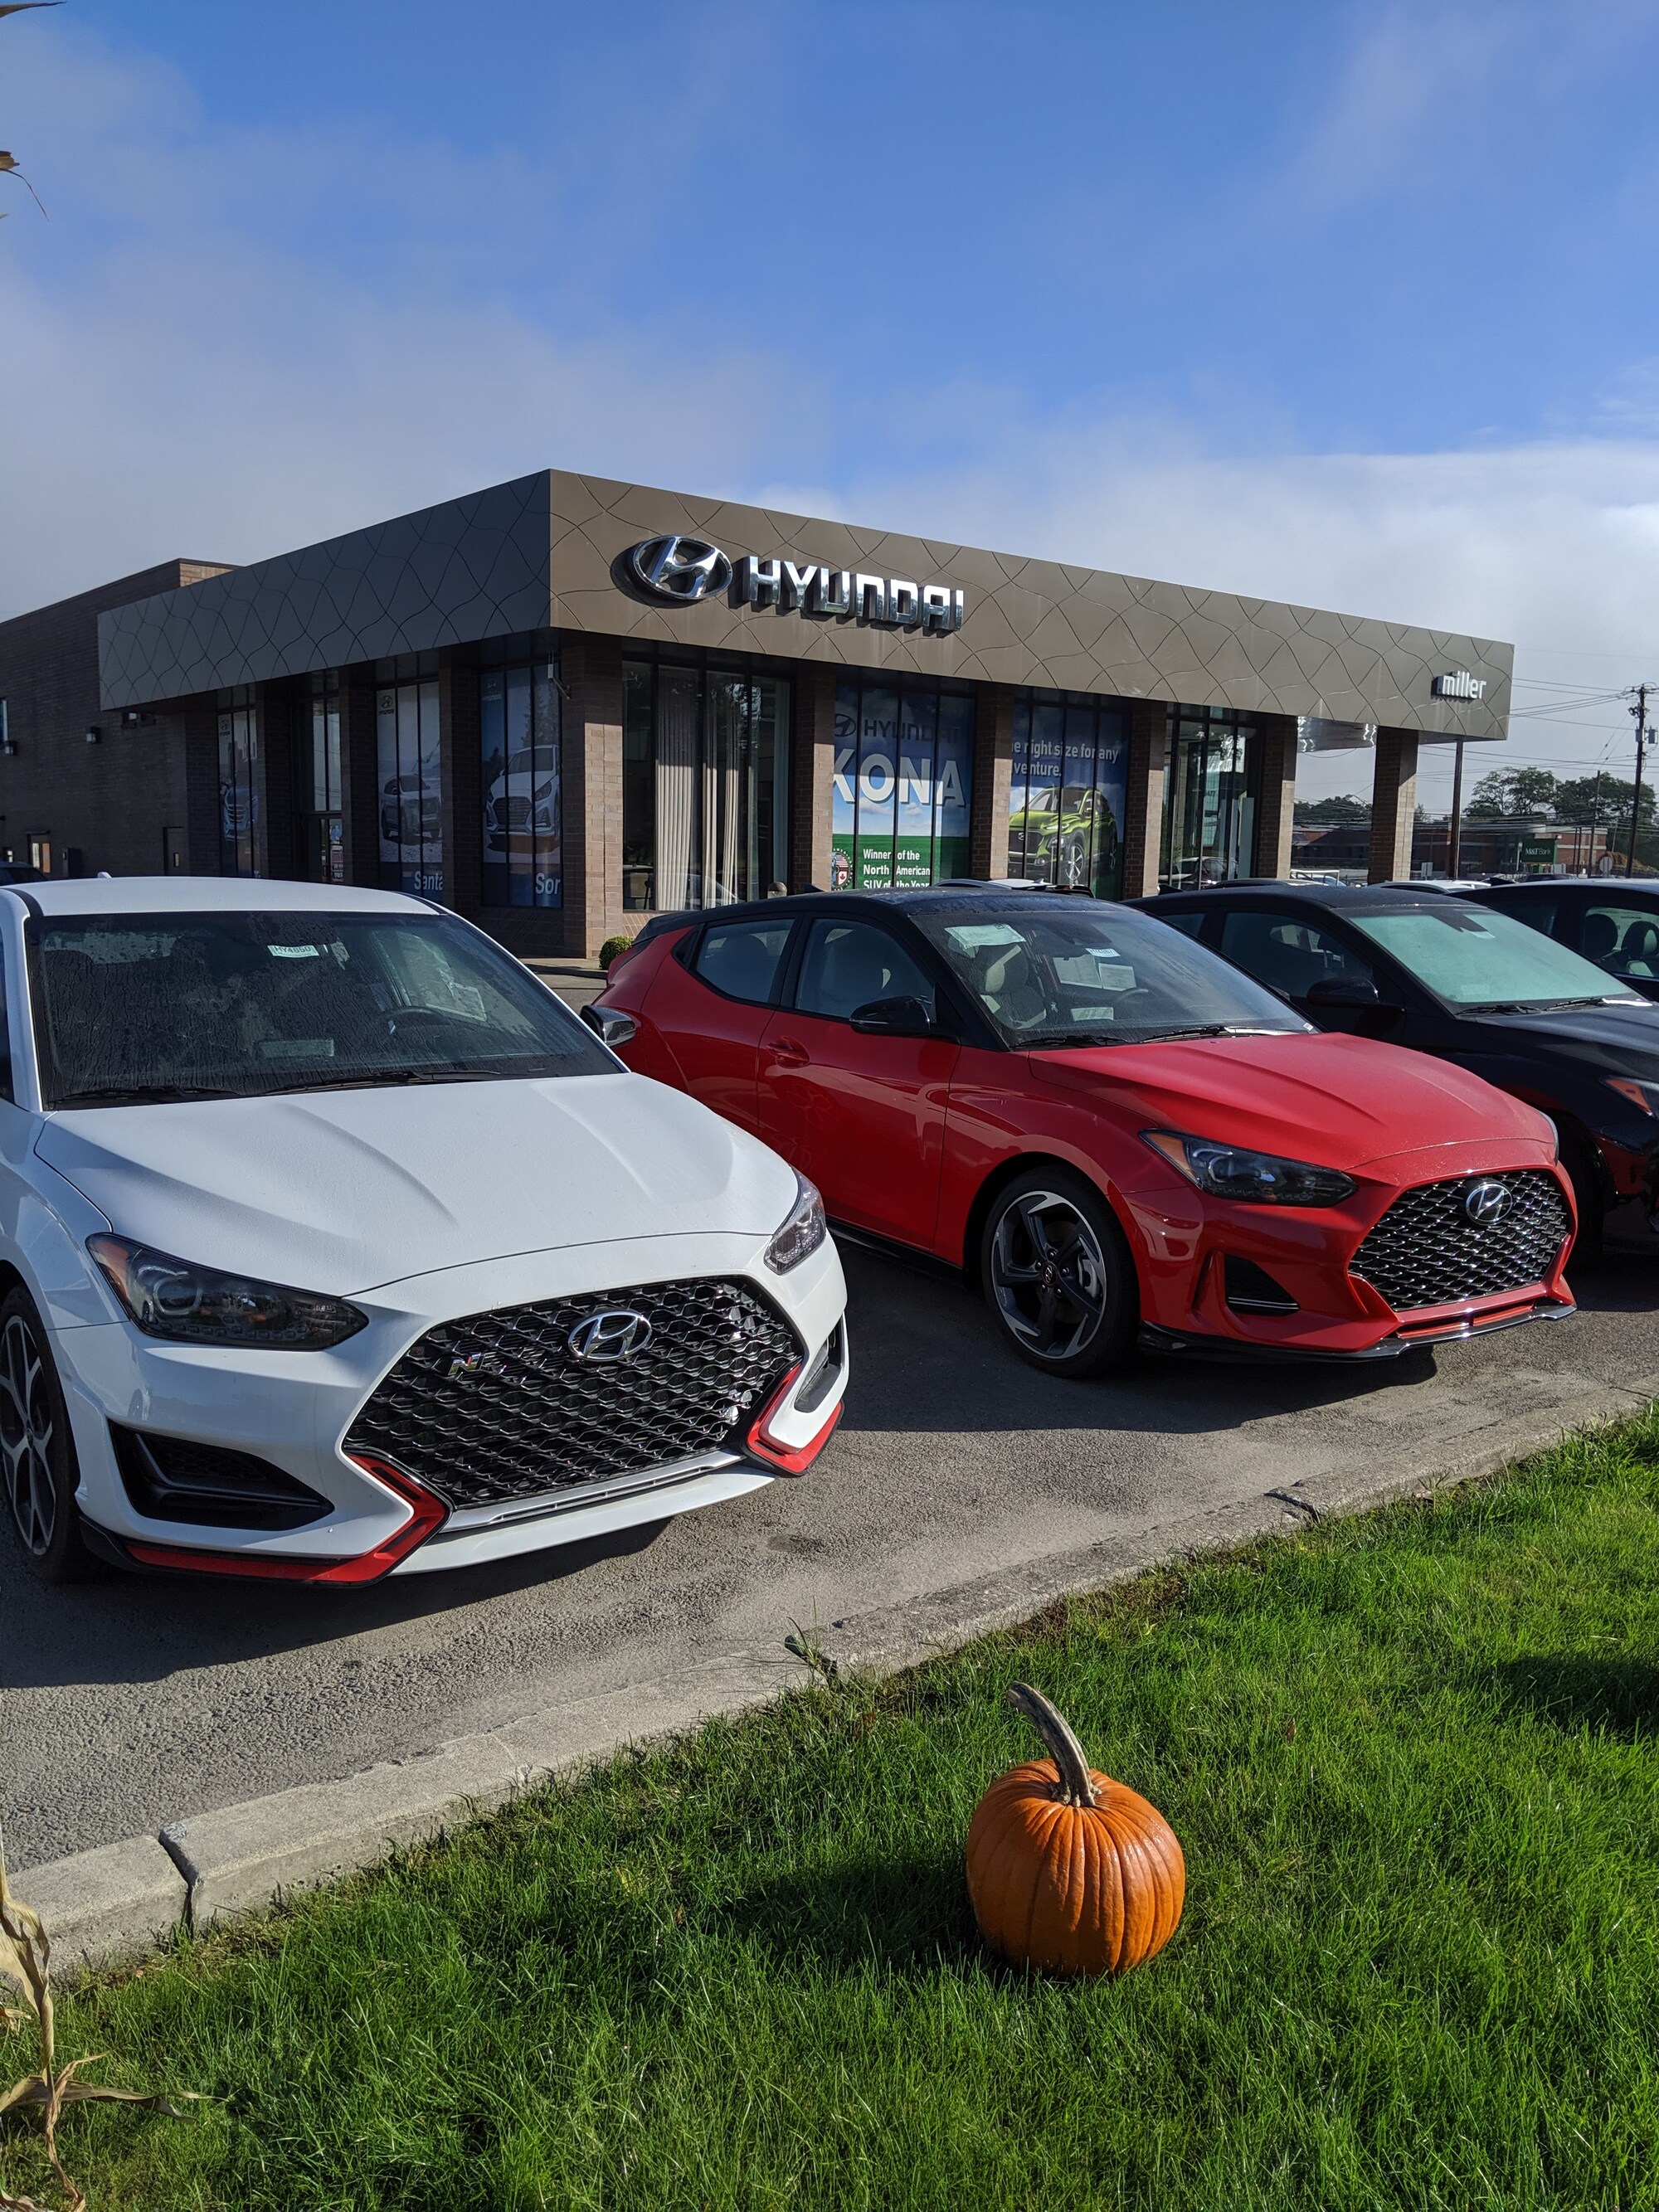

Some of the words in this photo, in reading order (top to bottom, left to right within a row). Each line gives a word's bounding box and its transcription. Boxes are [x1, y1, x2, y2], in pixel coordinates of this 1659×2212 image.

[748, 555, 965, 632] HYUNDAI
[1442, 670, 1487, 699] miller
[1024, 739, 1053, 759] right
[1053, 741, 1079, 758] size
[1080, 743, 1097, 759] for
[1098, 748, 1120, 765] any
[1013, 761, 1062, 777] venture.
[863, 848, 892, 860] Winner
[897, 850, 906, 861] of
[907, 850, 921, 861] the
[863, 864, 890, 876] North
[895, 865, 931, 876] American
